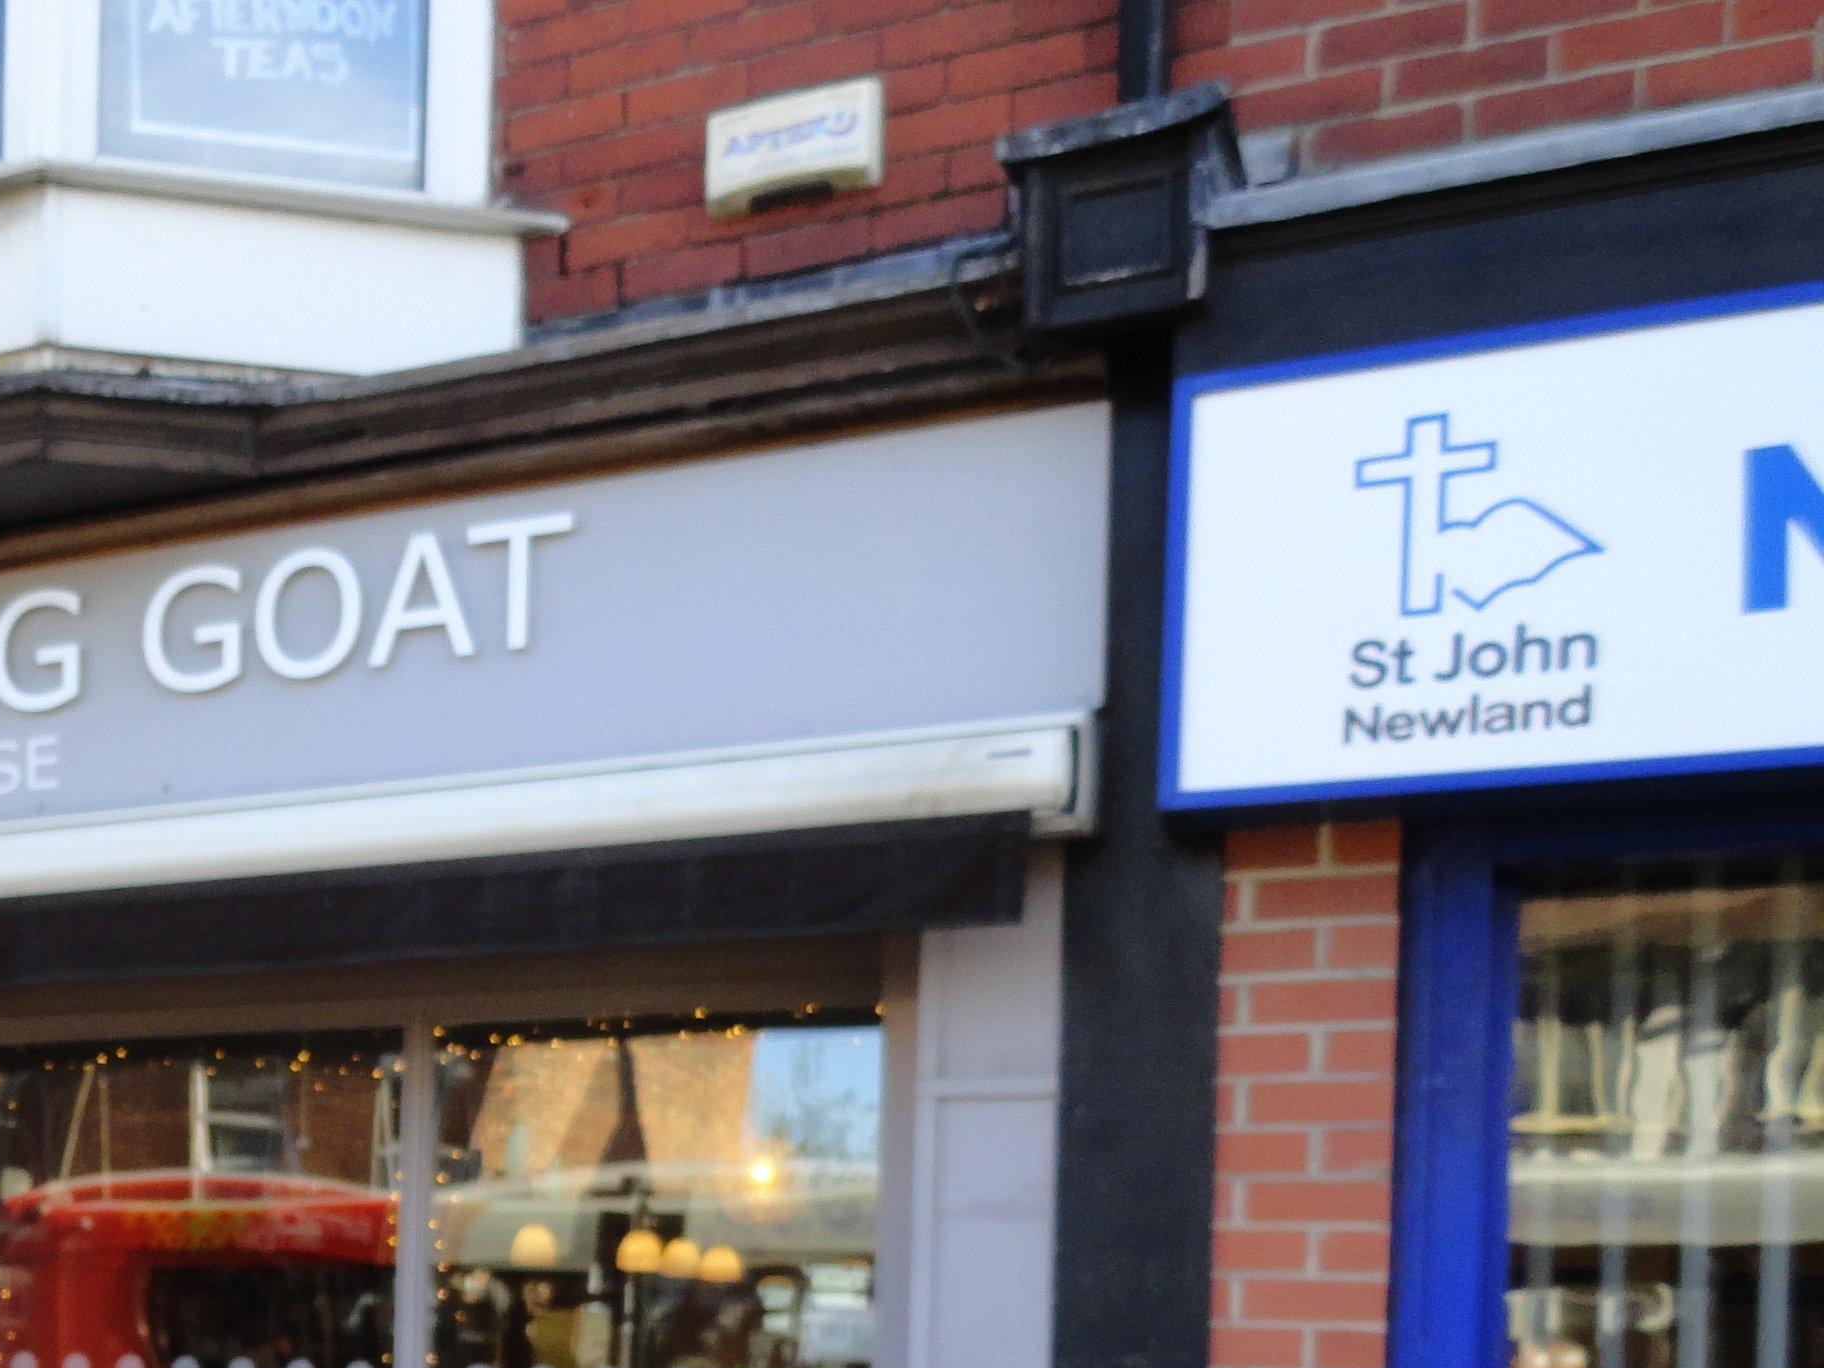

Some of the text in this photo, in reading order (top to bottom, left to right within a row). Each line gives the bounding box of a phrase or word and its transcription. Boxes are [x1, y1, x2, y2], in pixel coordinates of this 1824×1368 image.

[211, 37, 351, 84] TEAS
[141, 511, 575, 694] GOAT
[1349, 622, 1597, 689] St John
[1342, 683, 1593, 744] Newland
